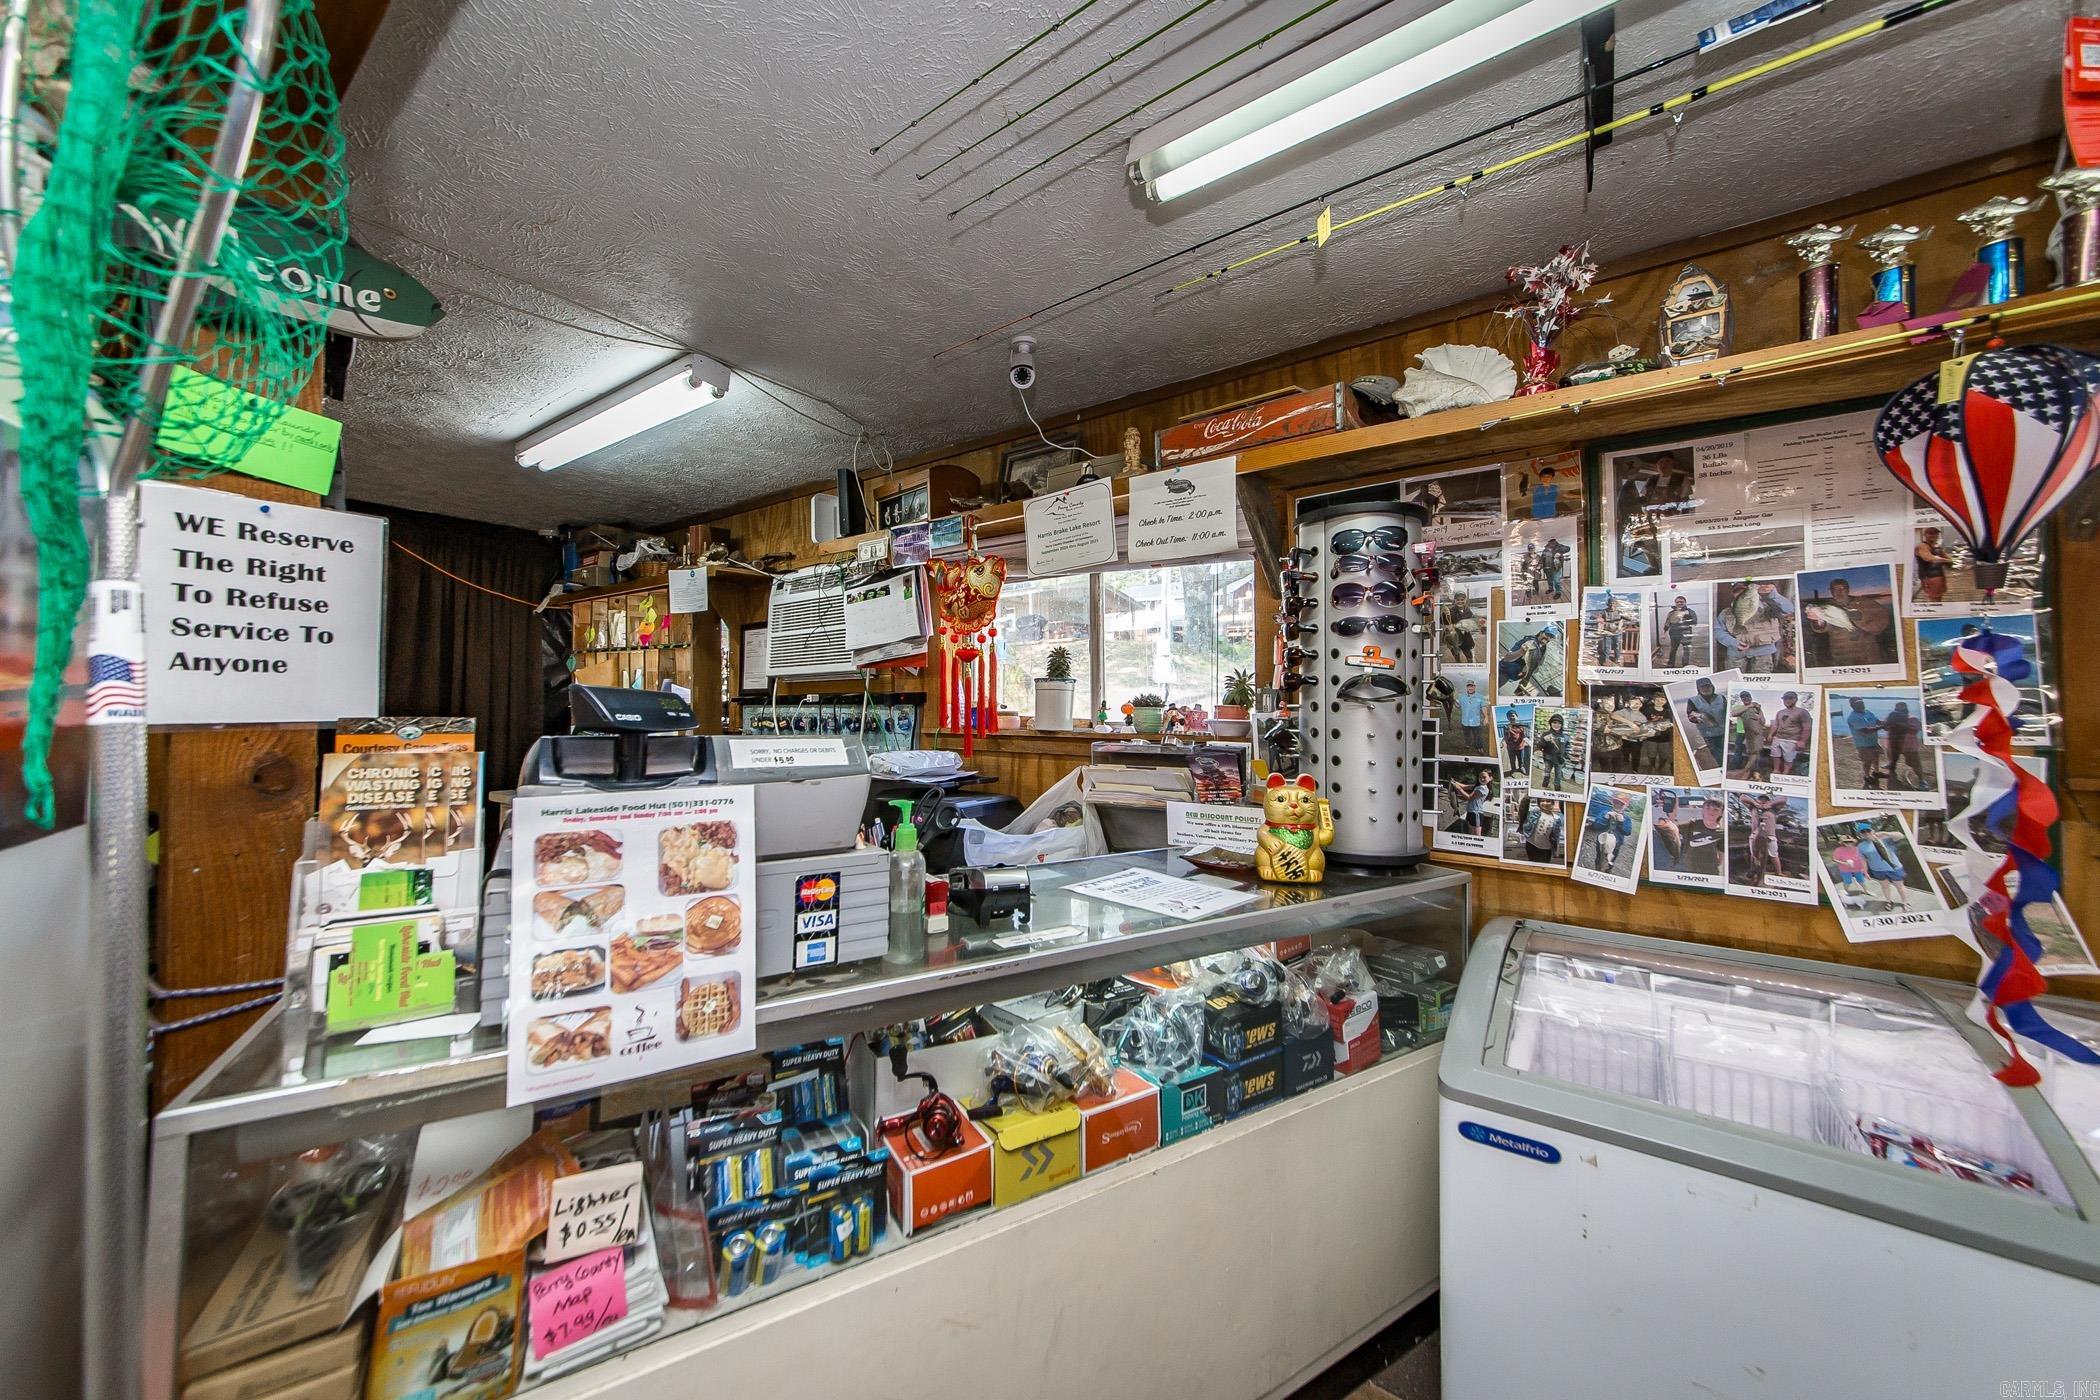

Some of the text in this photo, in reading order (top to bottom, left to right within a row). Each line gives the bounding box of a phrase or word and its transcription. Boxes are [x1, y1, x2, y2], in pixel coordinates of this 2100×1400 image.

[118, 203, 381, 313] Wcome
[1139, 518, 1158, 527] Check
[1188, 509, 1207, 519] 2:00
[174, 511, 354, 553] WE Reserve
[1054, 527, 1068, 536] Brake
[1069, 524, 1082, 532] Lake
[1082, 520, 1101, 529] Resort
[1136, 538, 1154, 547] Check
[1155, 537, 1168, 545] Out
[1191, 530, 1210, 541] 11:00
[172, 548, 327, 584] The Right
[171, 582, 329, 613] To Refuse
[170, 617, 334, 644] Service To
[168, 652, 288, 676] Anyone
[346, 767, 421, 779] CHRONIC
[1608, 774, 1671, 786] 3/3/2020
[344, 779, 421, 791] WASTING
[346, 790, 416, 804] DISEASE
[541, 808, 572, 817] Harris
[575, 805, 619, 814] Lakeside
[622, 803, 646, 812] Food
[649, 802, 666, 810] Hut
[1200, 813, 1233, 821] DISCOUNT
[803, 914, 833, 929] VISA
[1862, 914, 1934, 928] 5/30/2021
[620, 1039, 663, 1057] coffee
[782, 1048, 839, 1068] SUPER HEAVY DUTY
[708, 1126, 777, 1152] SUPER HEAVY DUTY
[1489, 1133, 1549, 1158] Metalfrio
[816, 1163, 883, 1192] SUPER HEAVY DUTY
[553, 1182, 639, 1217] Lighter
[718, 1212, 743, 1225] SUPER
[771, 1198, 792, 1209] DUTY
